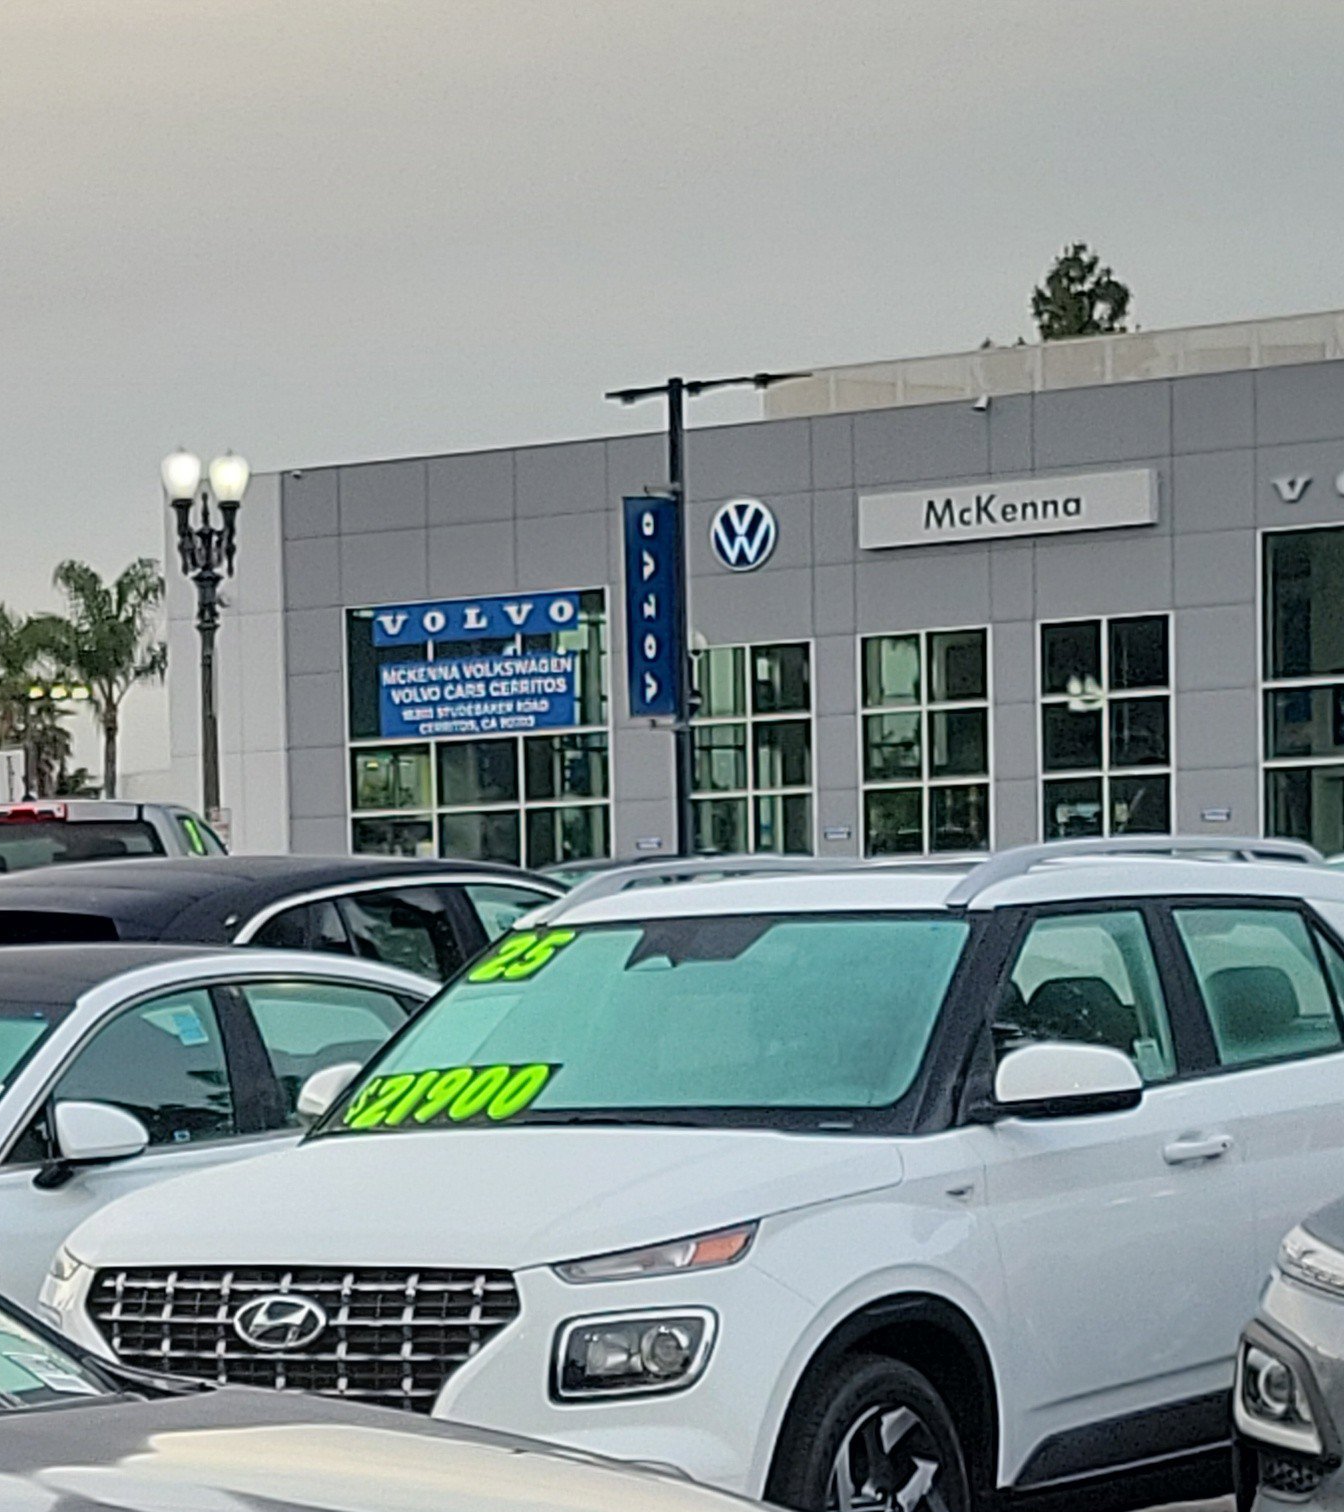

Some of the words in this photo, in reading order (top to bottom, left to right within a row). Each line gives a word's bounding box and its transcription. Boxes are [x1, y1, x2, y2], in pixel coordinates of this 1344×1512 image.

[1272, 472, 1344, 502] V
[924, 494, 1082, 530] McKenna
[376, 600, 574, 635] VOLVO
[642, 511, 658, 703] VOLVO
[463, 657, 572, 679] VOLKSWAGEN
[391, 686, 440, 704] VOLVO
[444, 681, 485, 700] CARS
[489, 677, 567, 697] CERRITOS
[468, 930, 576, 982] 25
[343, 1064, 550, 1129] $21900
